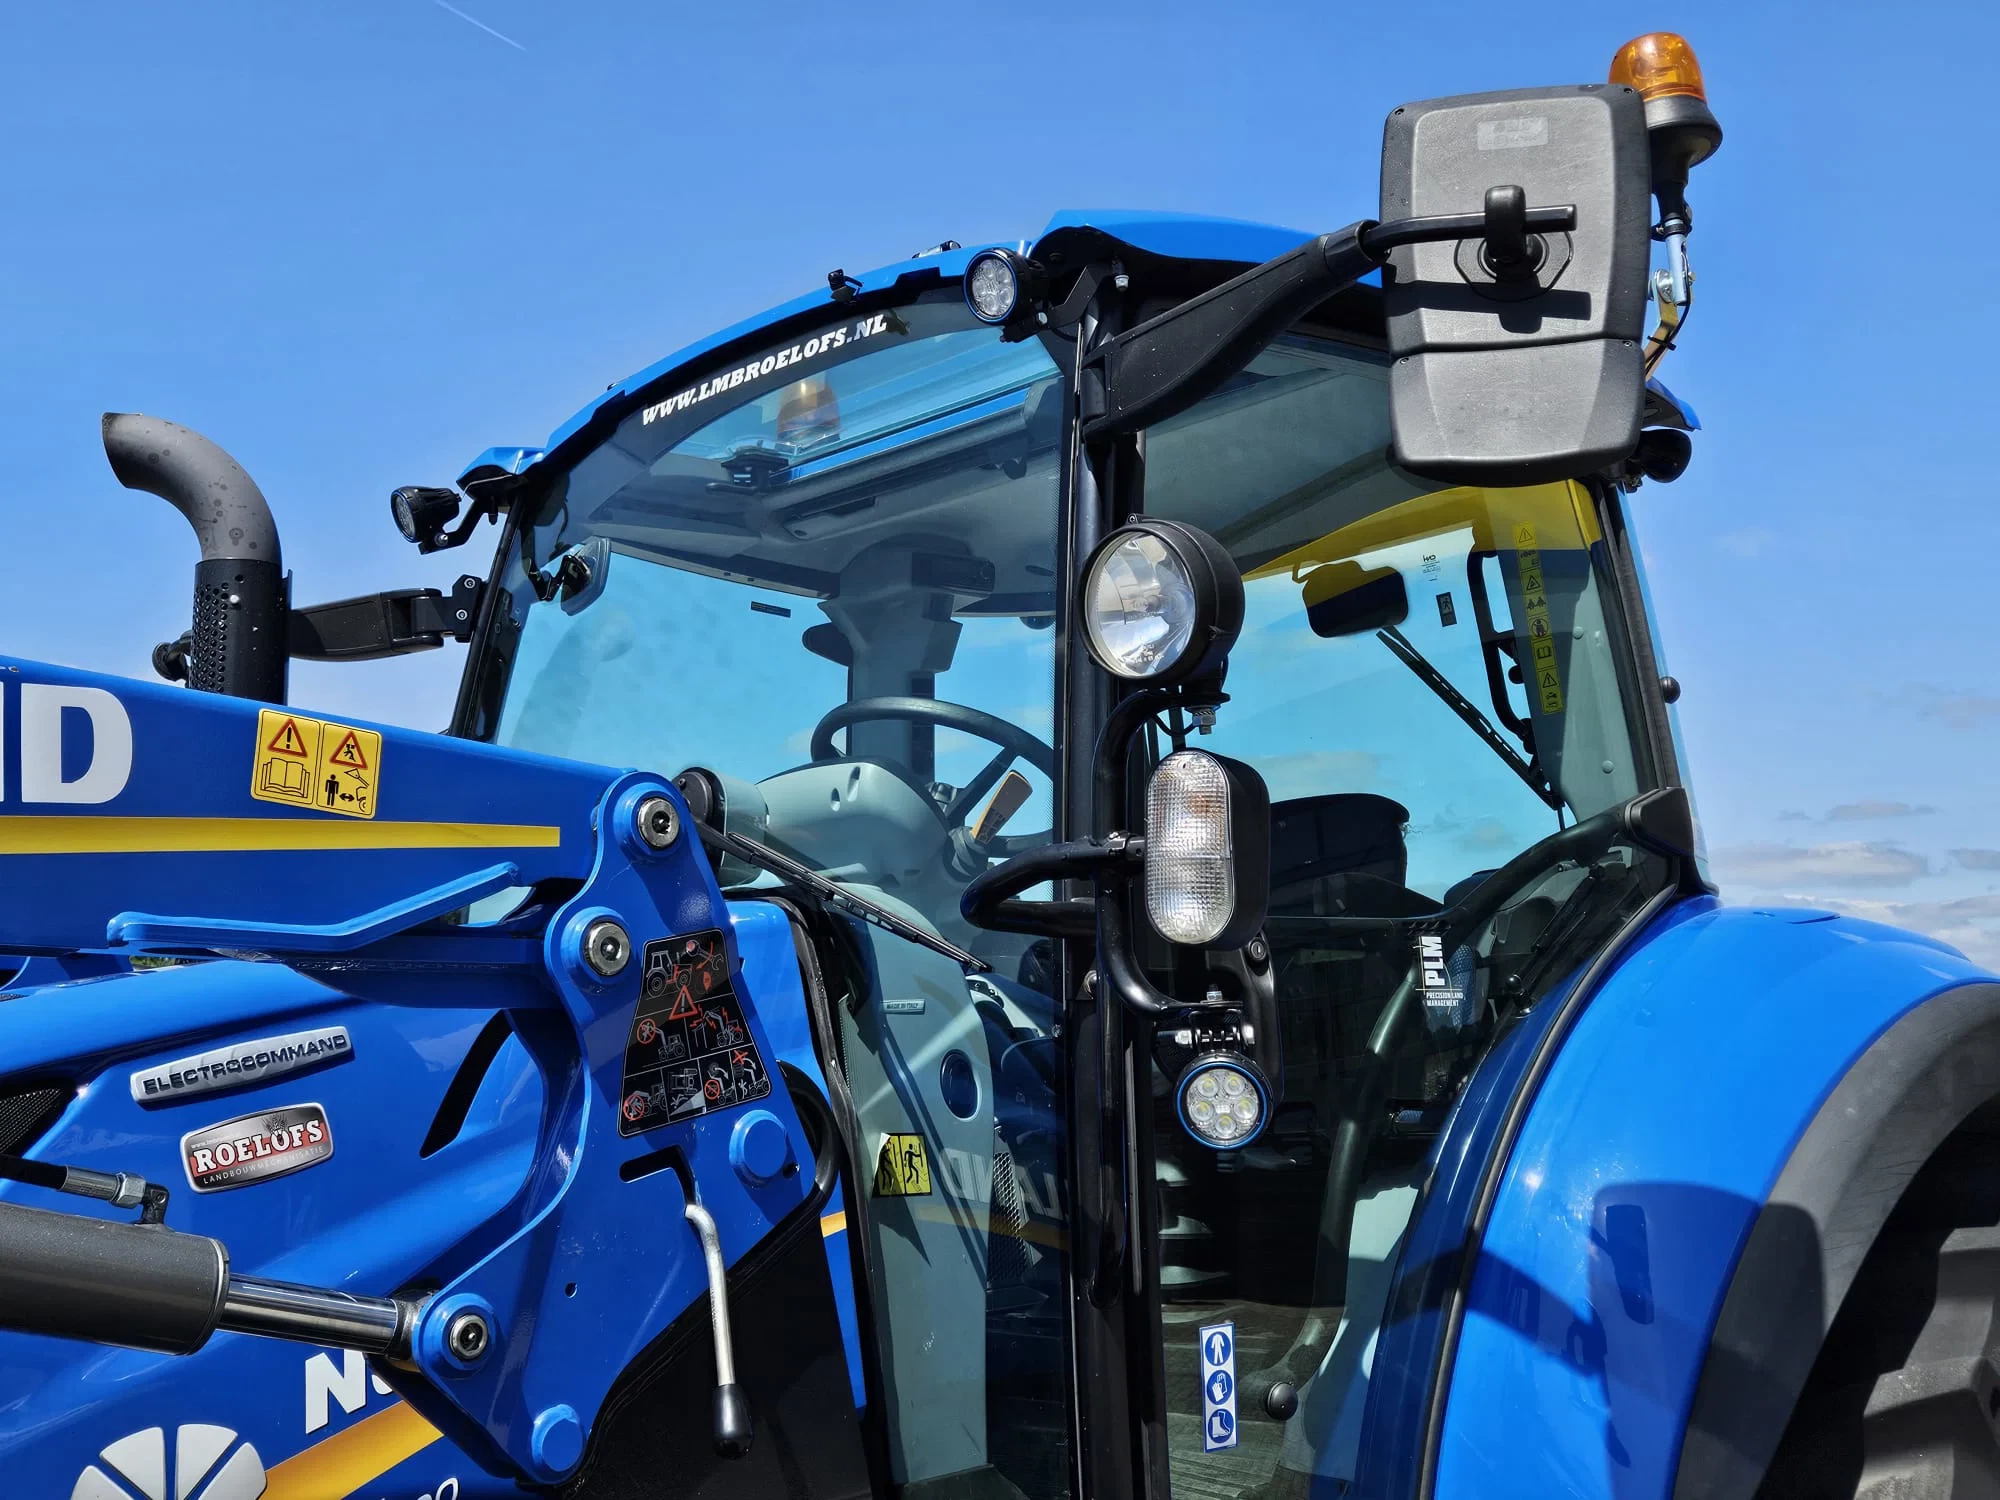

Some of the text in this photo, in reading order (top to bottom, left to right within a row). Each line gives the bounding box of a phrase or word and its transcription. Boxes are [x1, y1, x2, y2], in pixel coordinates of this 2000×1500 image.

[642, 314, 888, 426] WWW.LMBROELOFS.NL
[0, 681, 133, 805] D
[1421, 936, 1446, 986] PLM
[143, 1034, 347, 1095] ELECTROCOMMAND
[203, 1145, 325, 1185] LANDBOUWMECHANISATIE
[305, 1349, 394, 1435] N
